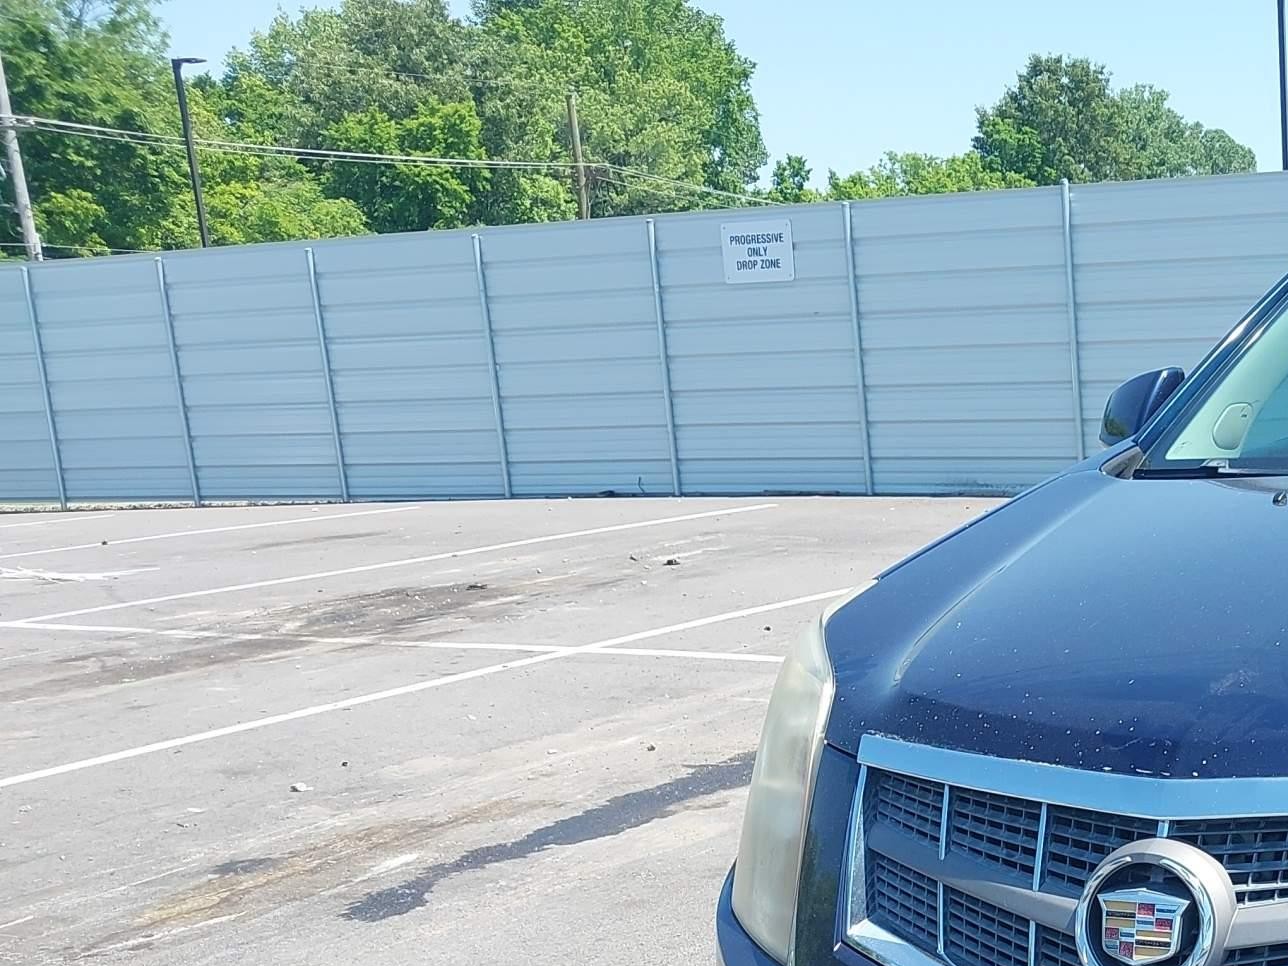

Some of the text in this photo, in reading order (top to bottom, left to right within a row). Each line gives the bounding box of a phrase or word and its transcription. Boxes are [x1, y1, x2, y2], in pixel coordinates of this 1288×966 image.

[729, 232, 784, 245] PROGRESSIVE
[747, 246, 768, 257] ONLY
[736, 258, 782, 271] DROP ZONE
